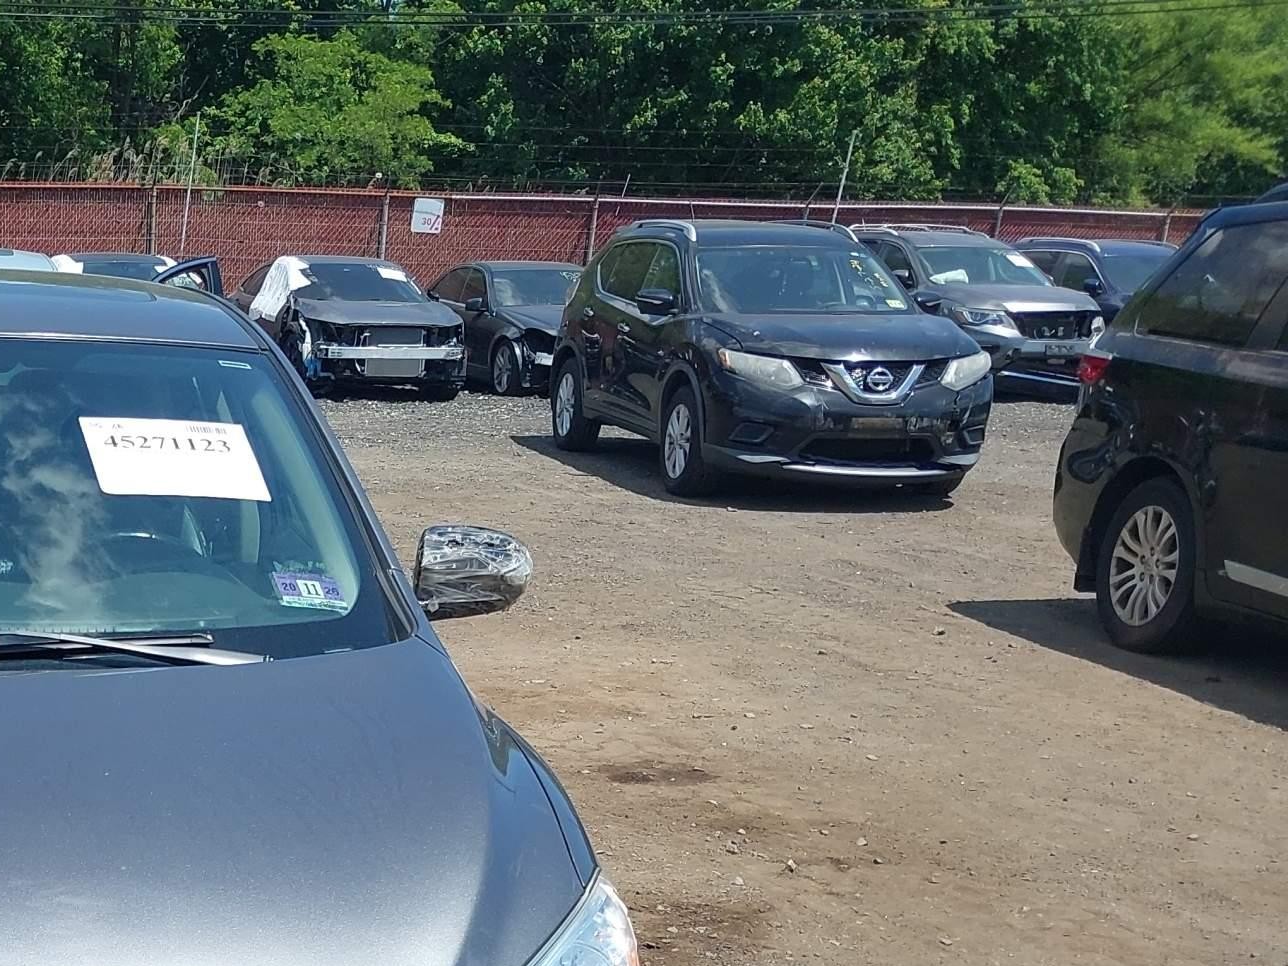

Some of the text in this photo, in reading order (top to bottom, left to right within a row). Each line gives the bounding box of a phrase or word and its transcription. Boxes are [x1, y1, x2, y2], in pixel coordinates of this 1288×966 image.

[103, 434, 231, 453] 45271123
[281, 582, 297, 592] 20
[302, 582, 321, 597] 11
